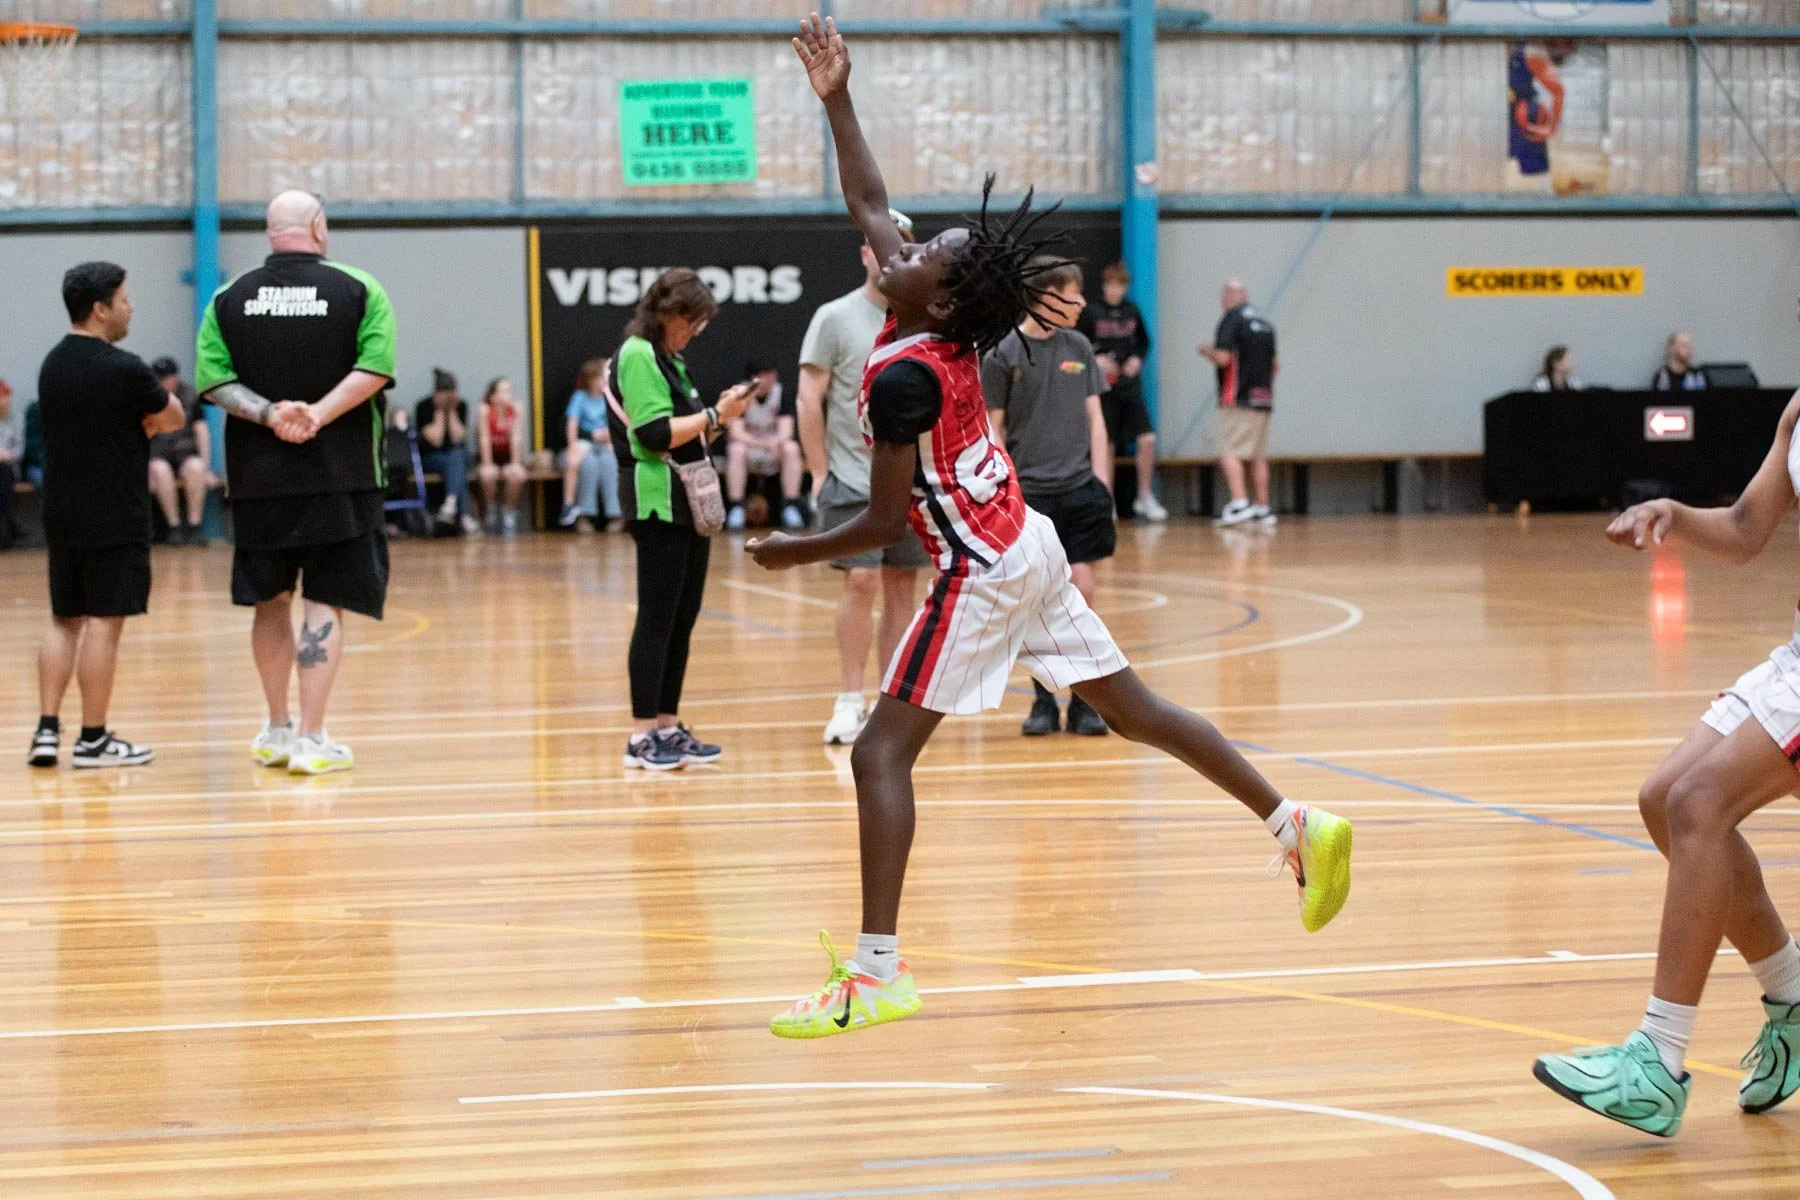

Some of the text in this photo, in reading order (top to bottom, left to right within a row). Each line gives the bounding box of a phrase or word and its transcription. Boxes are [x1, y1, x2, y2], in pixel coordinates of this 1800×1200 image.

[642, 121, 736, 146] HERE
[546, 265, 802, 306] VISIORS
[1454, 271, 1634, 291] SCORERS ONLY
[257, 286, 317, 300] STADIUM
[244, 299, 328, 316] SUPERVISOR
